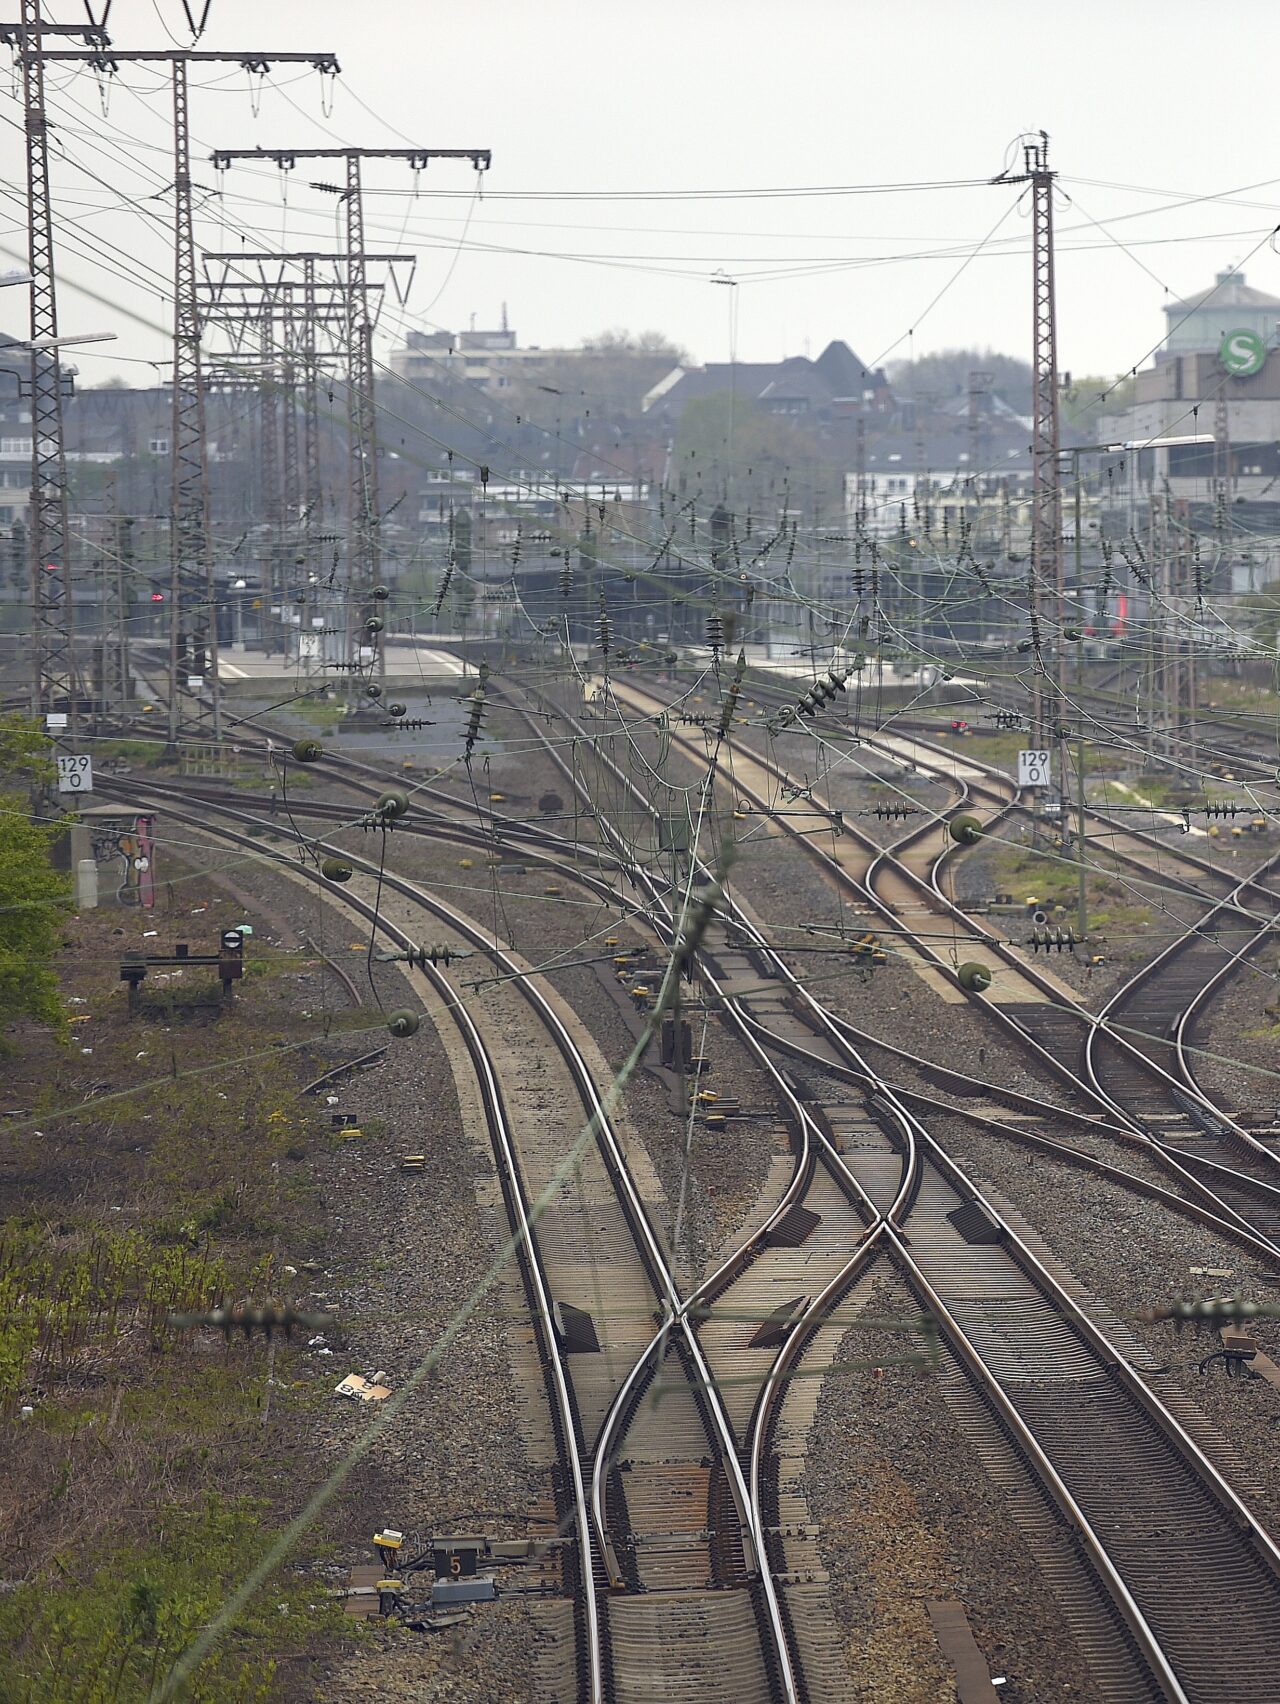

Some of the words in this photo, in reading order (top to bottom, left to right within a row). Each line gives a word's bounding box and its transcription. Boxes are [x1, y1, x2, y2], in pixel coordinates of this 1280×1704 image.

[1230, 336, 1257, 370] S
[60, 756, 89, 772] 129
[1021, 752, 1048, 766] 129
[70, 773, 81, 788] 0
[1029, 767, 1040, 781] 0
[341, 1116, 348, 1126] 7
[450, 1556, 461, 1574] 5
